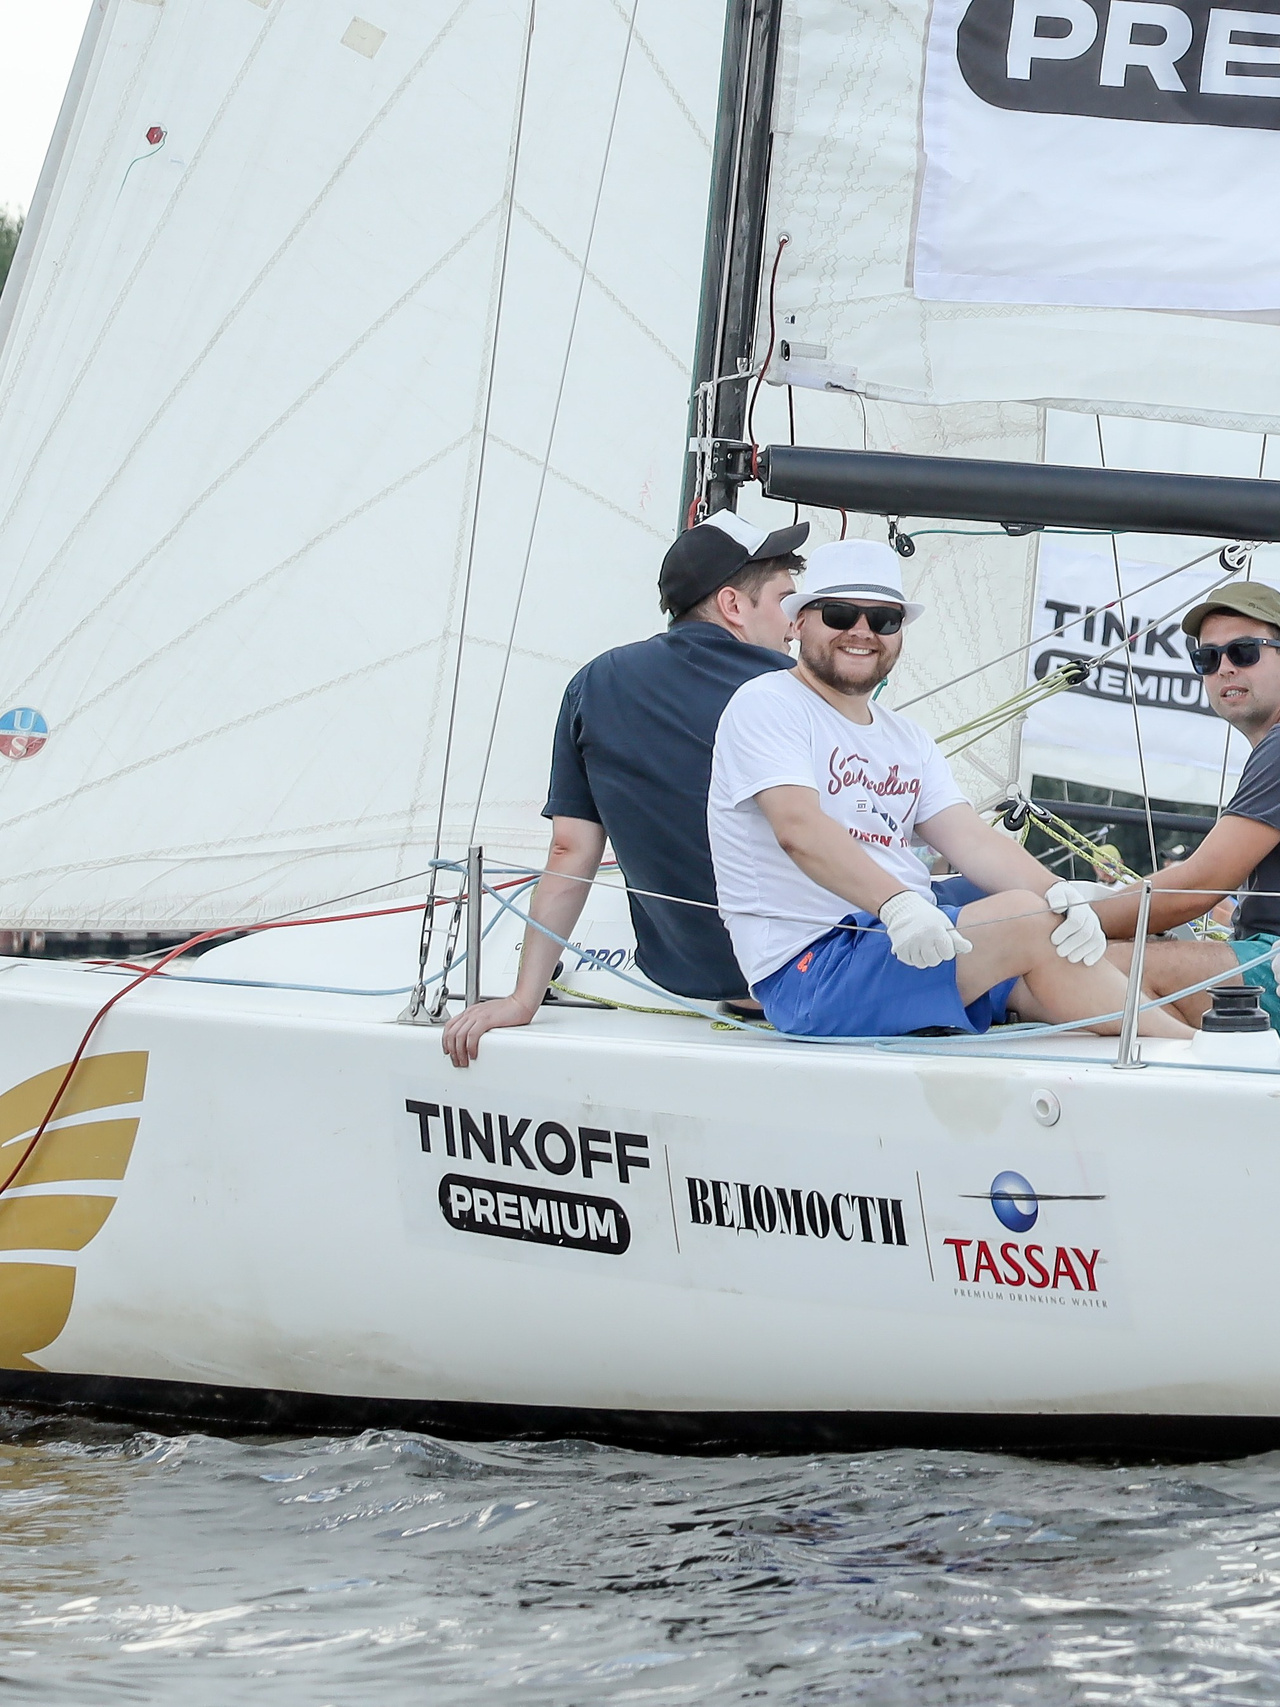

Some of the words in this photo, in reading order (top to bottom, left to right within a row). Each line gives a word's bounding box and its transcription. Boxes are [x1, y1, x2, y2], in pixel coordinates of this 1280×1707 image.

[405, 1099, 650, 1184] TINKOFF
[449, 1184, 619, 1244] PREMIUM
[685, 1176, 909, 1247] ВЕДОМОСТИ
[943, 1238, 1101, 1292] TASSAY
[953, 1287, 1004, 1301] PREMIUM
[1009, 1292, 1067, 1306] DRINKING
[1072, 1297, 1108, 1308] WATER
